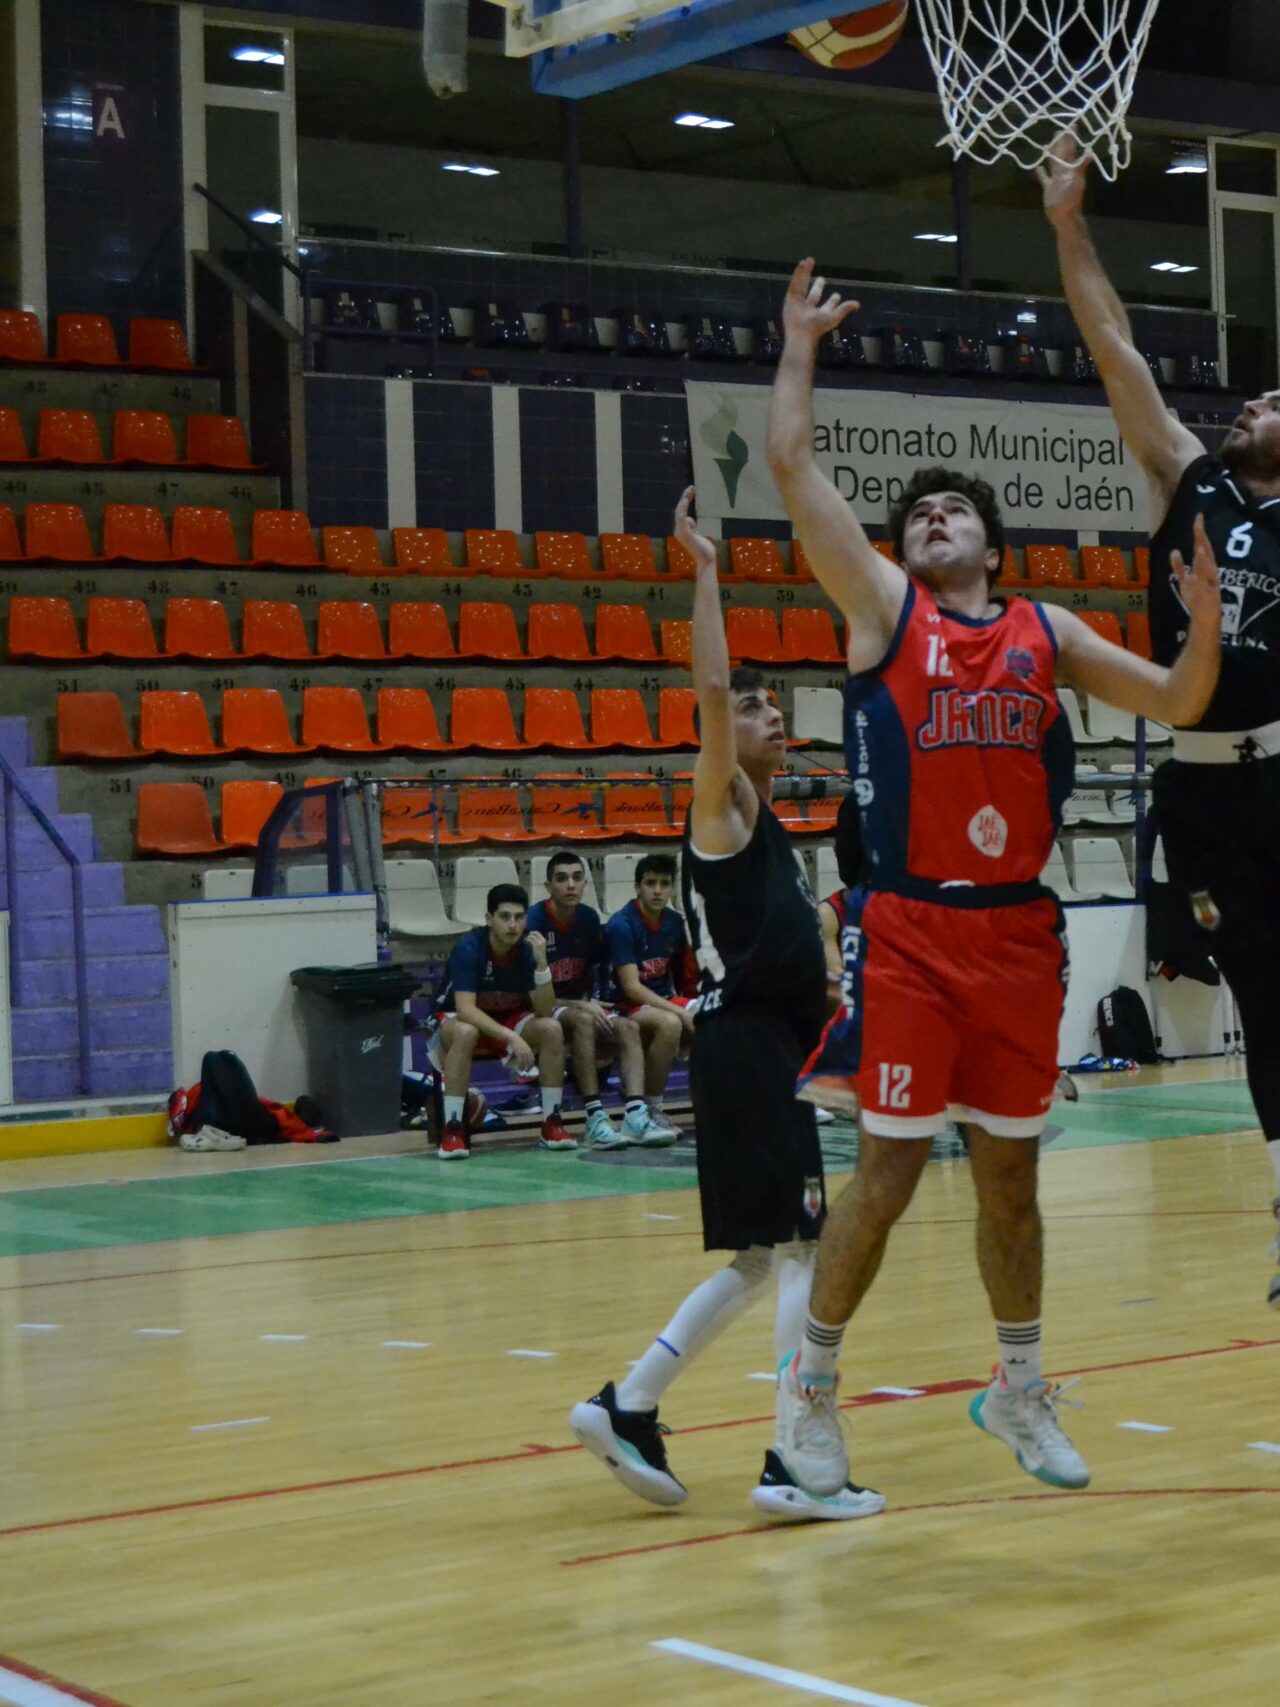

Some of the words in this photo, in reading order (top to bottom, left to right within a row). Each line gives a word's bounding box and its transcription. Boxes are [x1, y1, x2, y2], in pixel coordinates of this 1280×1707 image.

[97, 97, 127, 139] A
[814, 418, 957, 459] atronato
[970, 424, 1124, 473] Municipal
[1004, 473, 1043, 509] de
[1056, 476, 1134, 512] Jaén
[1225, 520, 1254, 559] 6
[877, 1061, 913, 1110] 12
